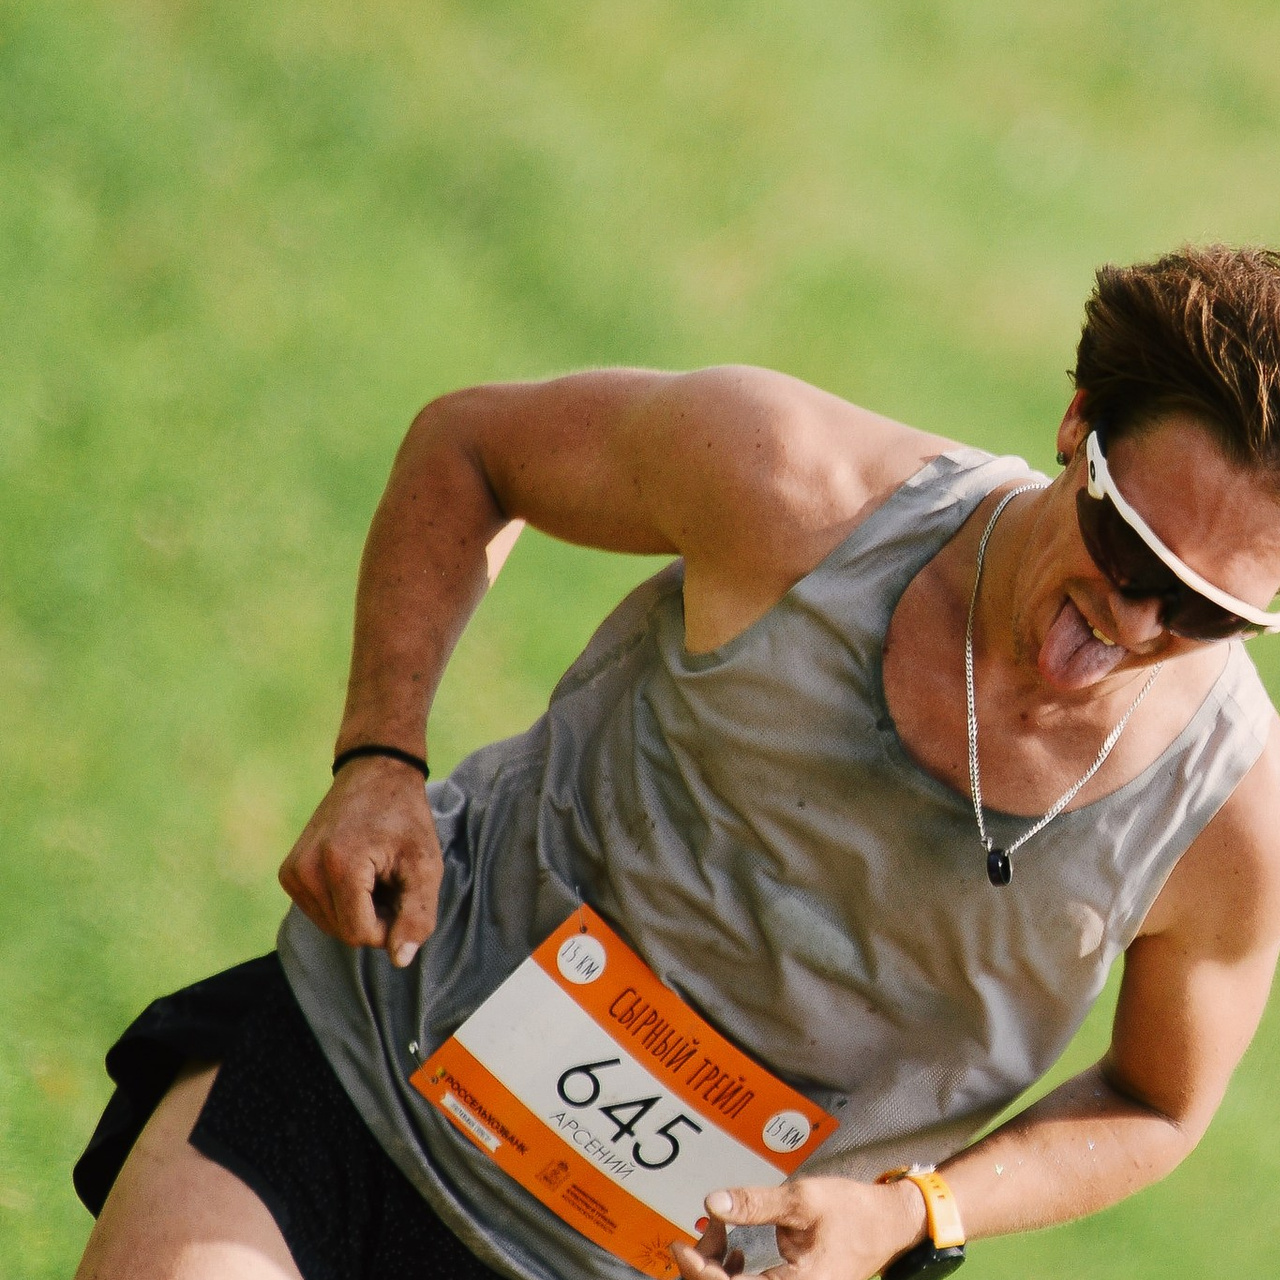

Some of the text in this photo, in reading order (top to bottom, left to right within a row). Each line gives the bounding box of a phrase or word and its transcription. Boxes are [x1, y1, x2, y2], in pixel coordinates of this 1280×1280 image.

[561, 940, 580, 963] 15
[609, 987, 755, 1119] СЫРНЫЙ ТРЕЙЛ
[445, 1075, 528, 1156] РОССЕЛЬХОЗБАНК
[549, 1112, 635, 1180] АРСЕНИЙ
[557, 1058, 703, 1170] 645
[766, 1116, 786, 1137] 15
